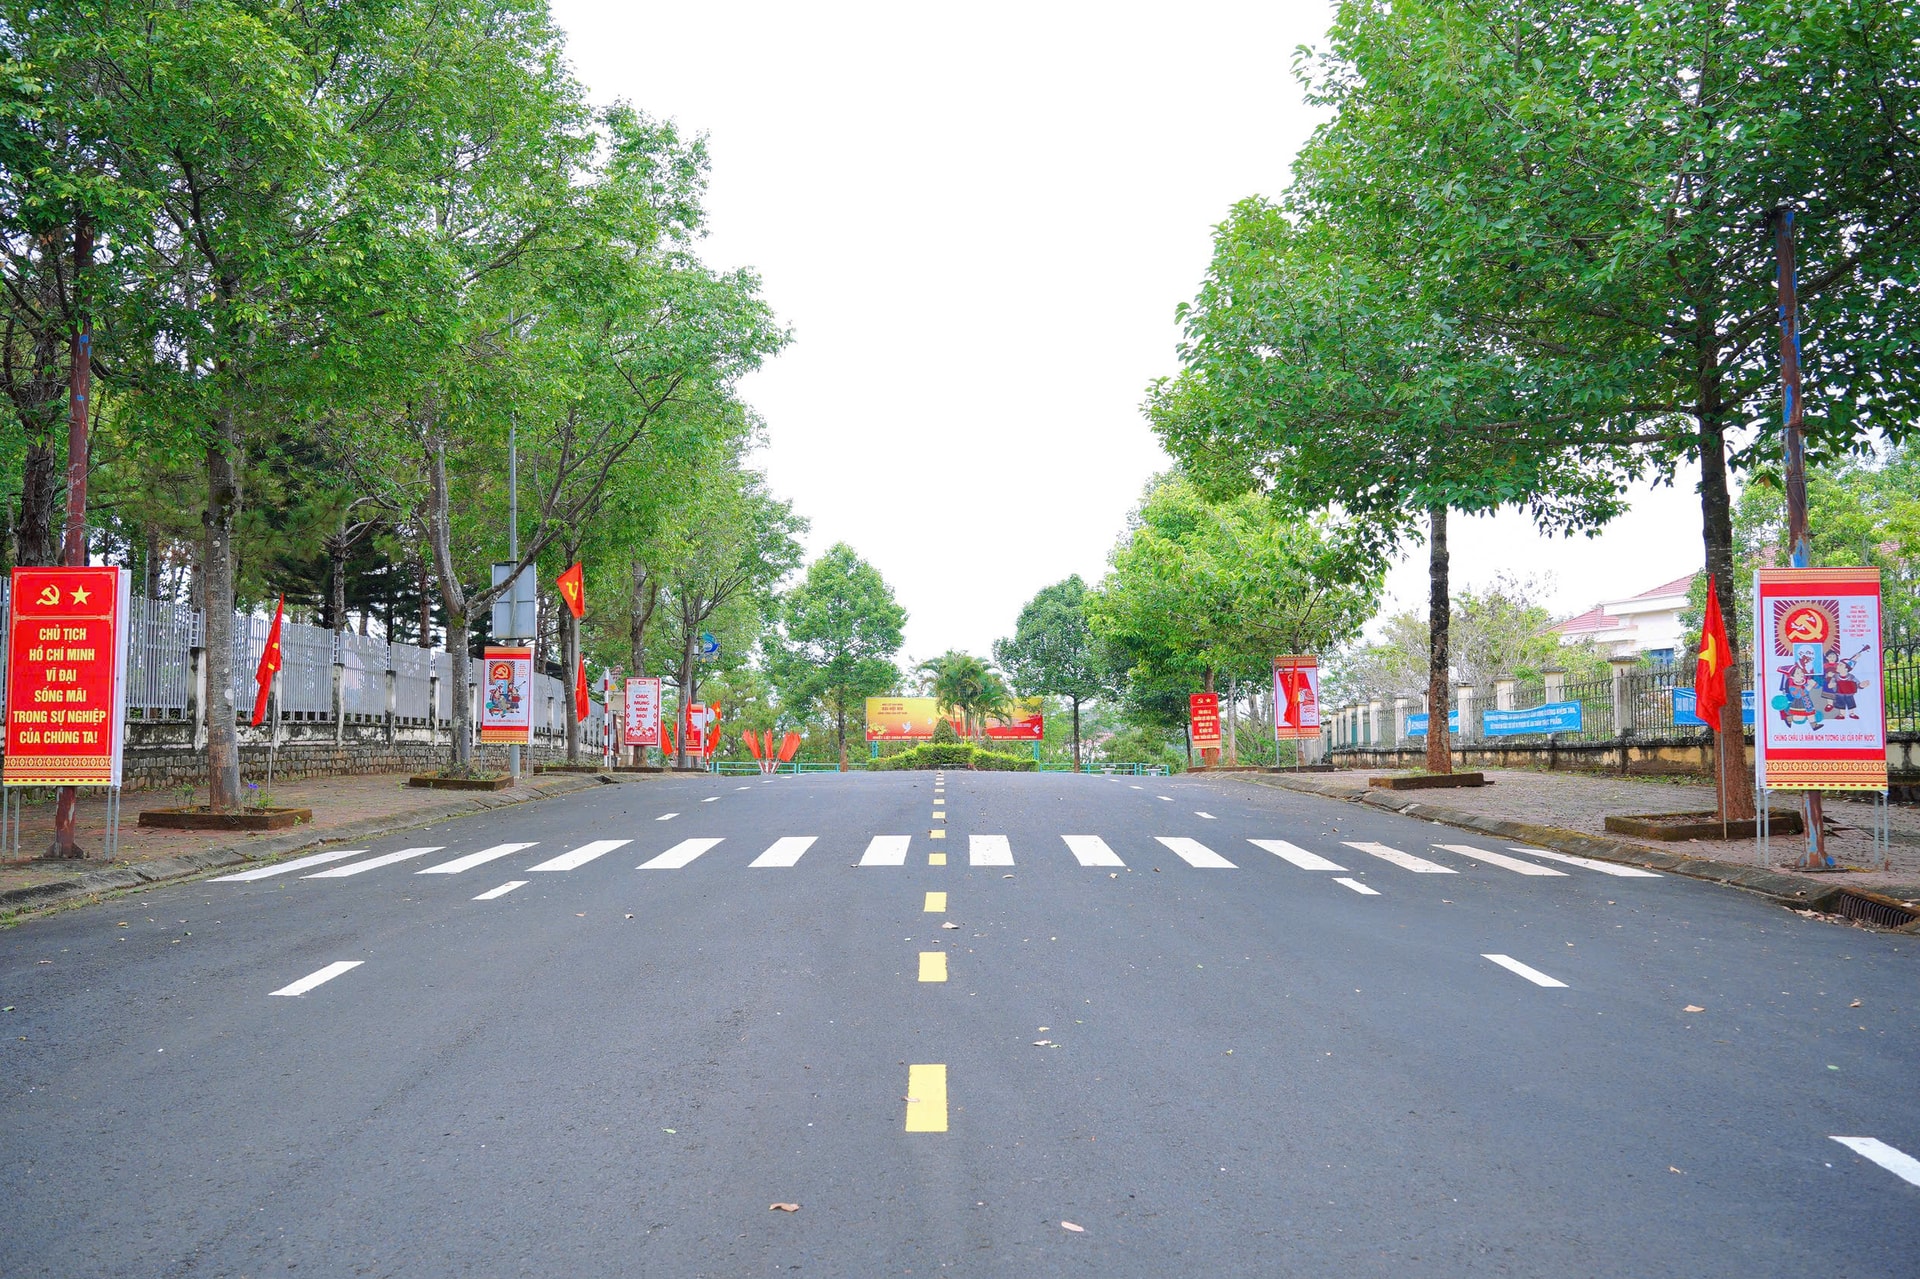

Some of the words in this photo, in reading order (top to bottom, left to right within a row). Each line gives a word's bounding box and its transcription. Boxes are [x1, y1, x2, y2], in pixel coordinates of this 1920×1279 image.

[40, 624, 60, 640] CHỦ
[63, 628, 86, 643] TỊCH
[46, 646, 64, 661] CHÍ
[67, 648, 95, 661] MINH
[46, 666, 56, 682] VĨ
[58, 669, 76, 684] ĐẠI
[34, 685, 64, 702] SỐNG
[66, 687, 86, 702] MÃI
[13, 710, 48, 723] TRONG
[50, 710, 66, 726] SỰ
[68, 708, 106, 726] NGHIỆP
[20, 727, 40, 744] CỦA
[44, 728, 79, 744] CHÚNG
[82, 731, 98, 744] TA!
